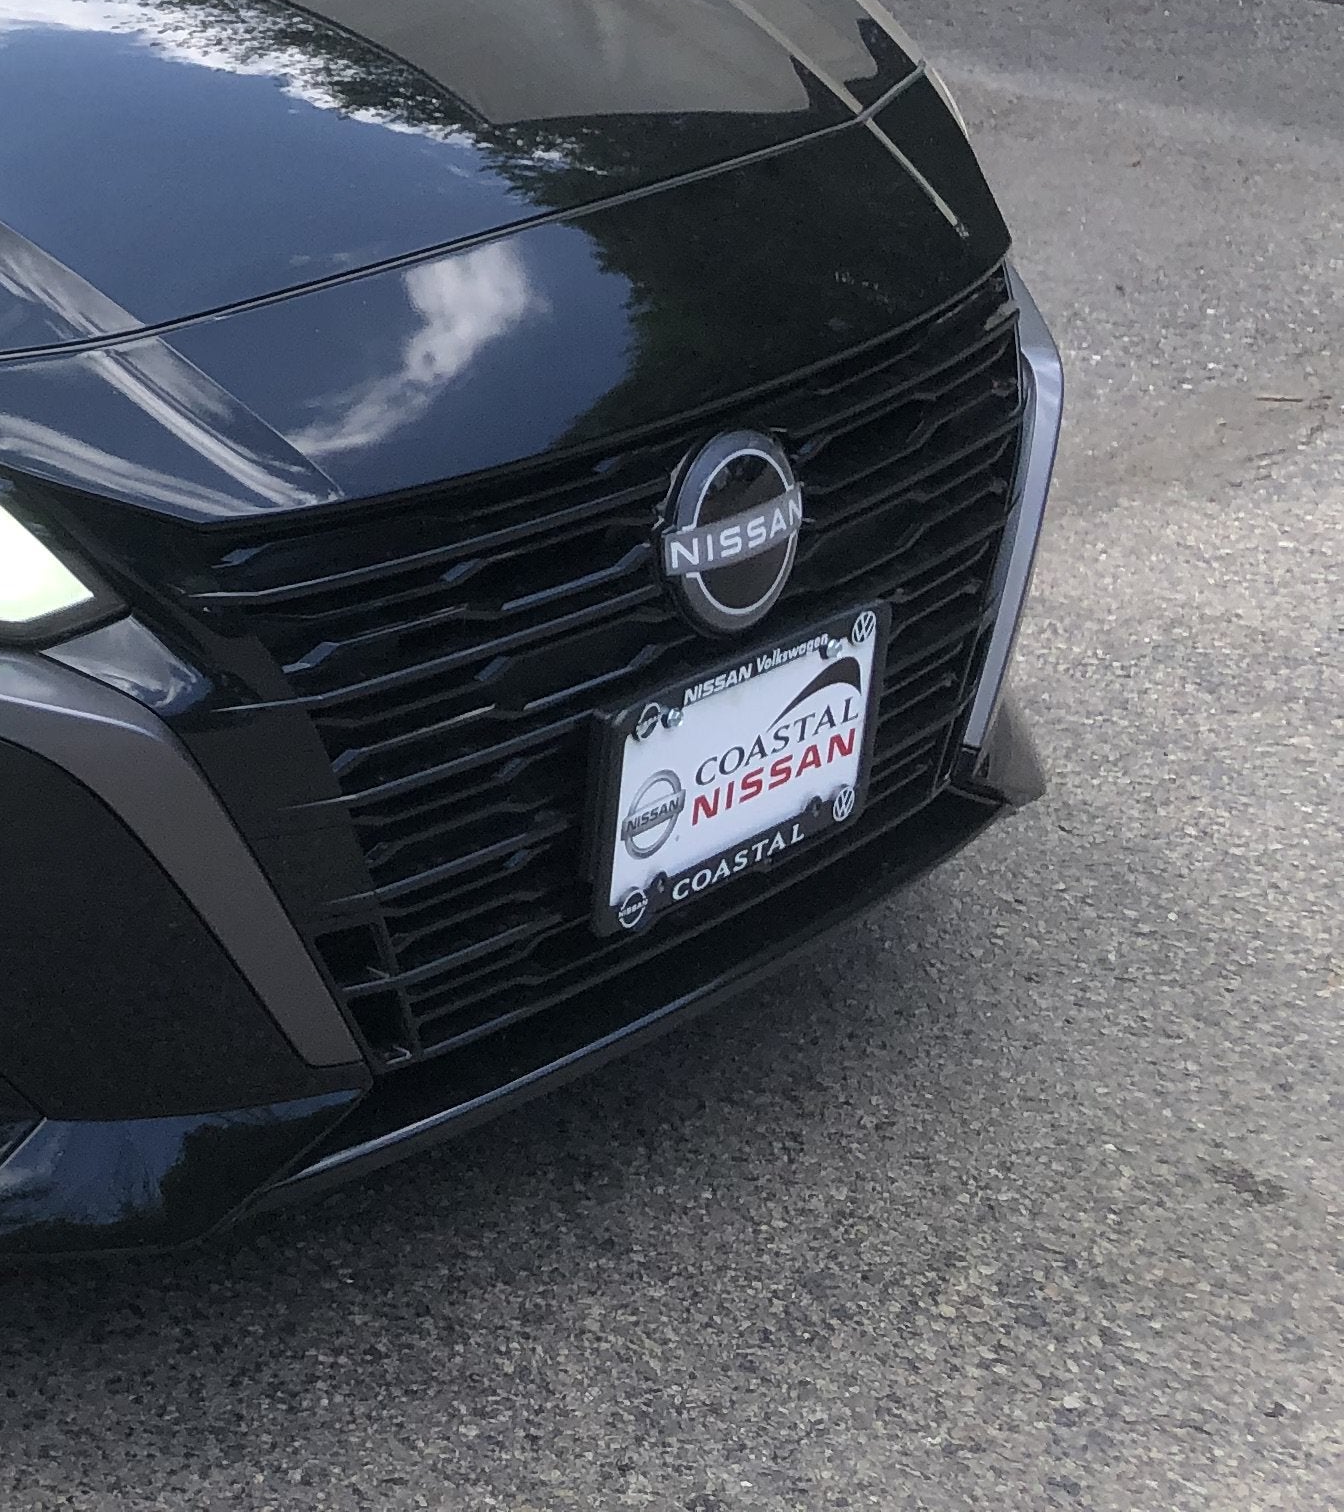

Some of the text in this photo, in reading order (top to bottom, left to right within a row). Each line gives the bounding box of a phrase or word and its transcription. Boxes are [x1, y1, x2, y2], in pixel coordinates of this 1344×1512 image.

[670, 491, 802, 568] NISSAN
[683, 633, 828, 705] NISSAN Volkswagen
[691, 728, 856, 827] NISSAN
[695, 696, 859, 786] COASTAL
[626, 796, 680, 833] NISSAN
[672, 823, 804, 901] COASTAL
